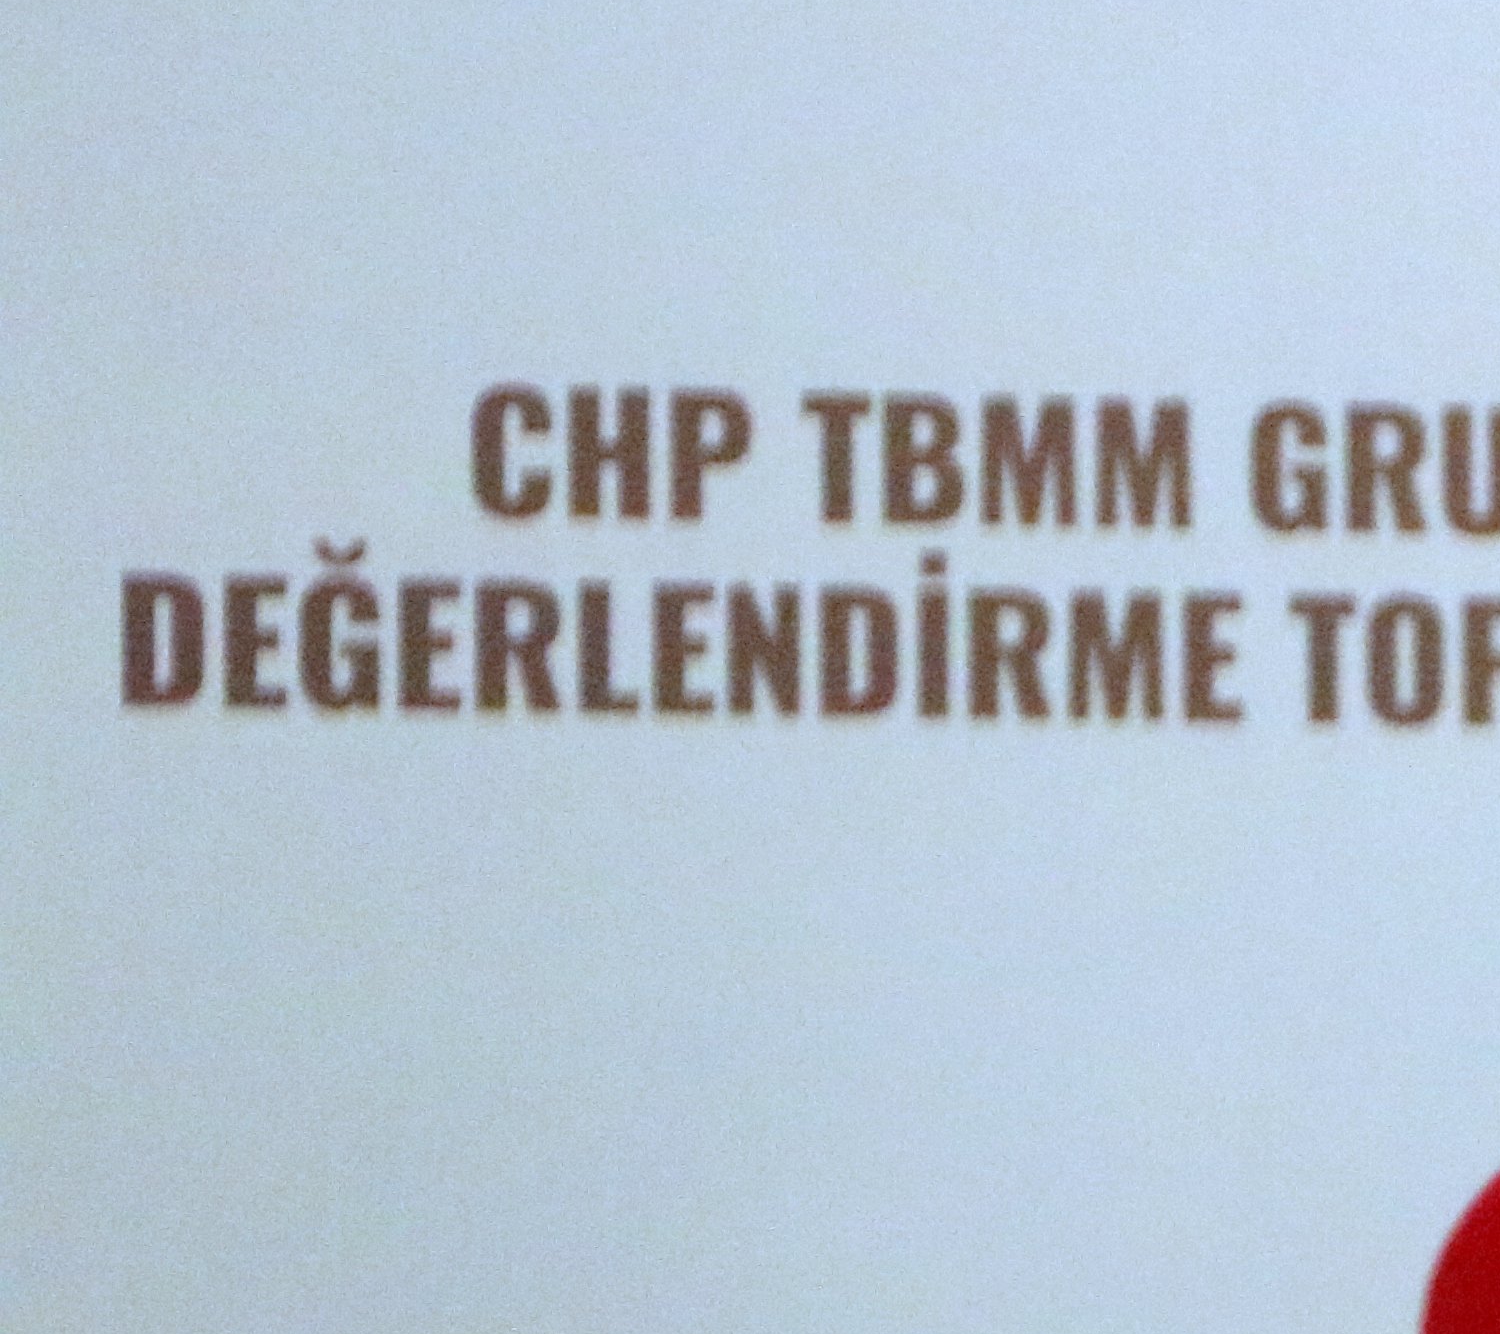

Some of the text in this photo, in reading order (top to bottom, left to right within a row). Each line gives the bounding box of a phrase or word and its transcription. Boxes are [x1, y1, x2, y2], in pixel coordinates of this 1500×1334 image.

[467, 381, 755, 527] CHP
[799, 387, 1195, 534] TBMM
[117, 537, 1247, 728] DEĞERLENDİRME
